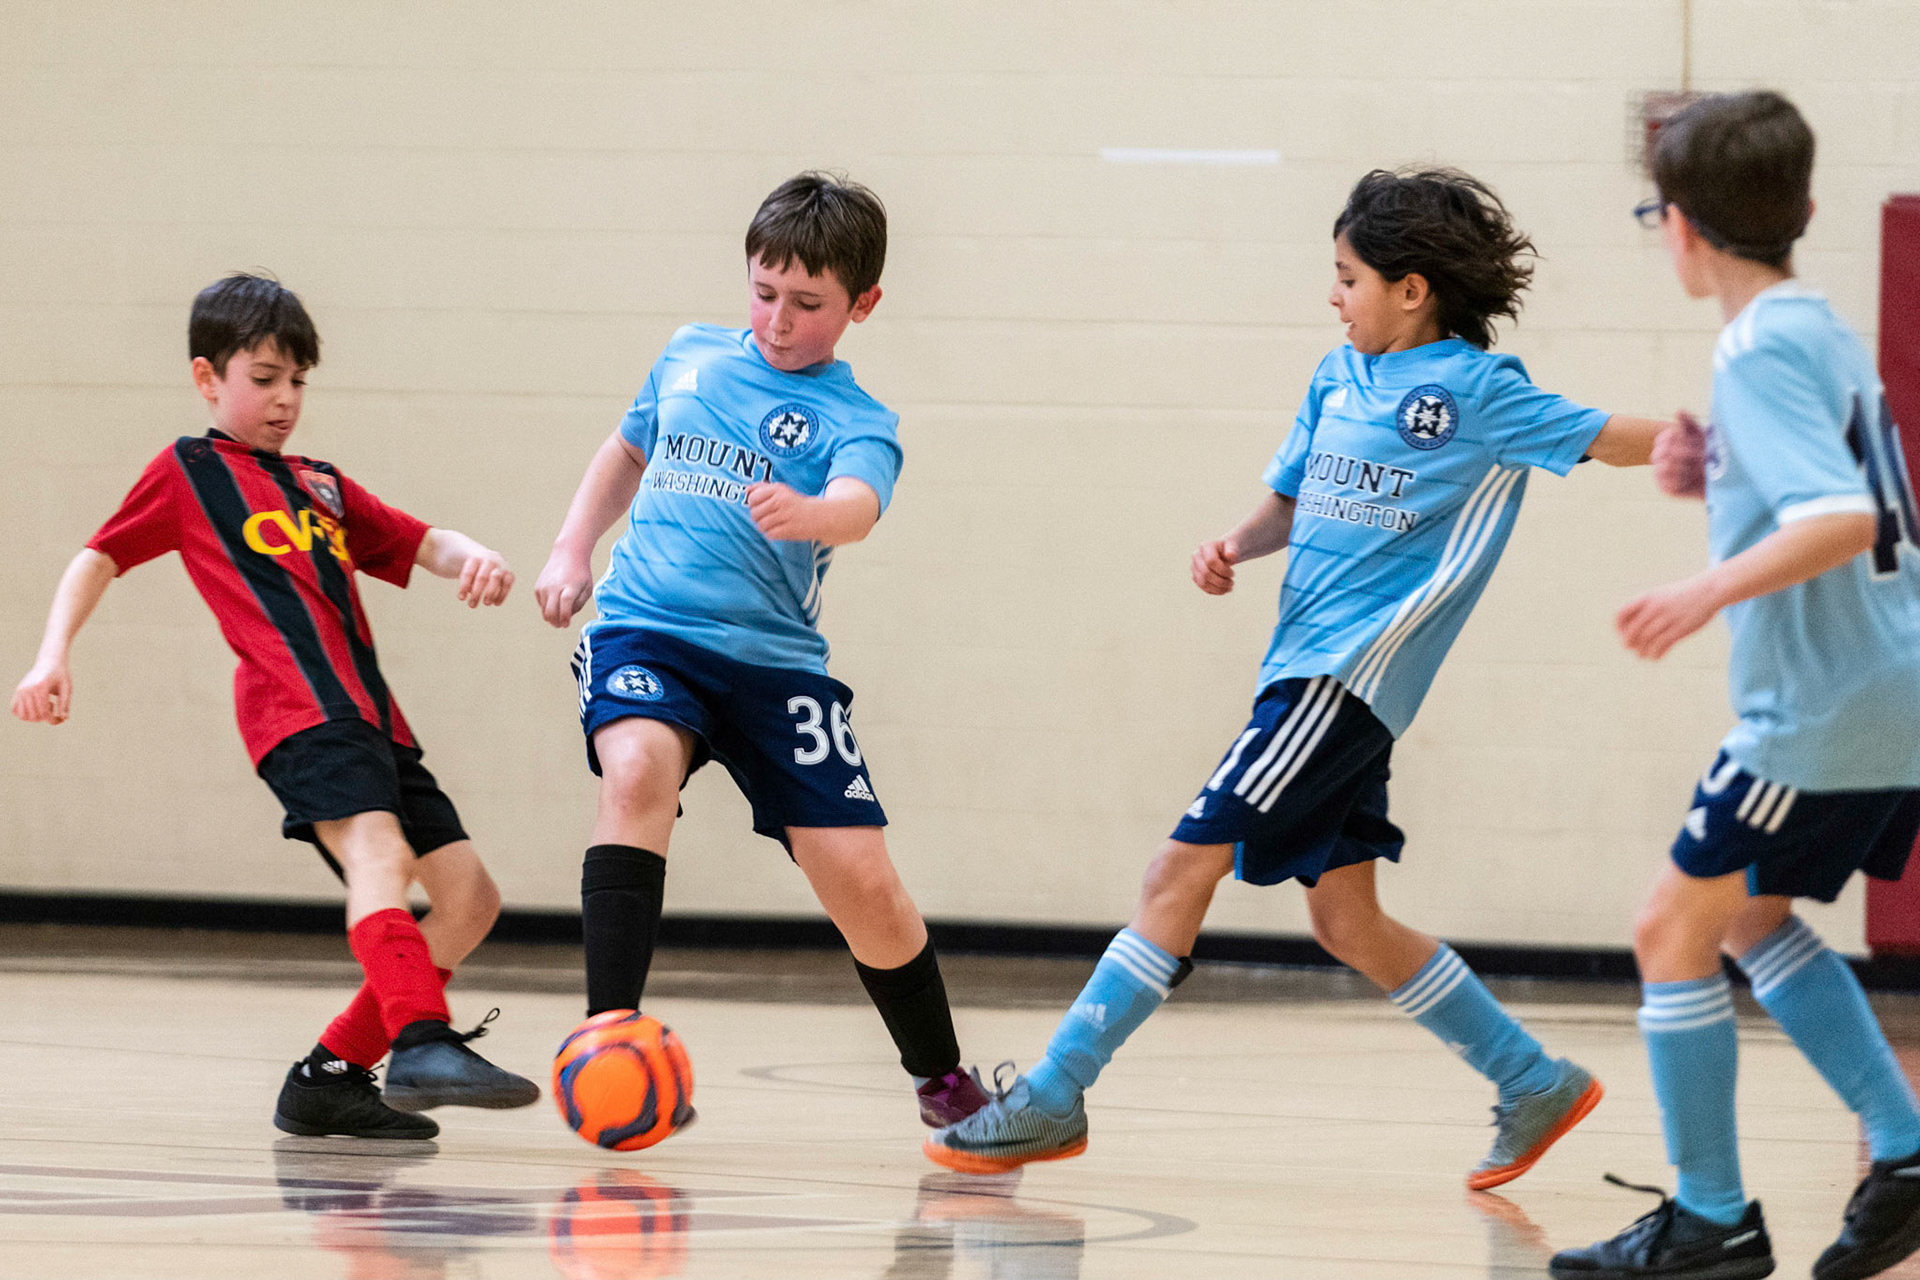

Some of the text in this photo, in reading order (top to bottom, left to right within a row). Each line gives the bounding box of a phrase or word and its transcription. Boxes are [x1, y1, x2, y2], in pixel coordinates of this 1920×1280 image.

[664, 433, 773, 484] MOUNT
[1307, 453, 1415, 497] MOUNT
[652, 471, 750, 505] WASHINGT
[787, 695, 862, 767] 36
